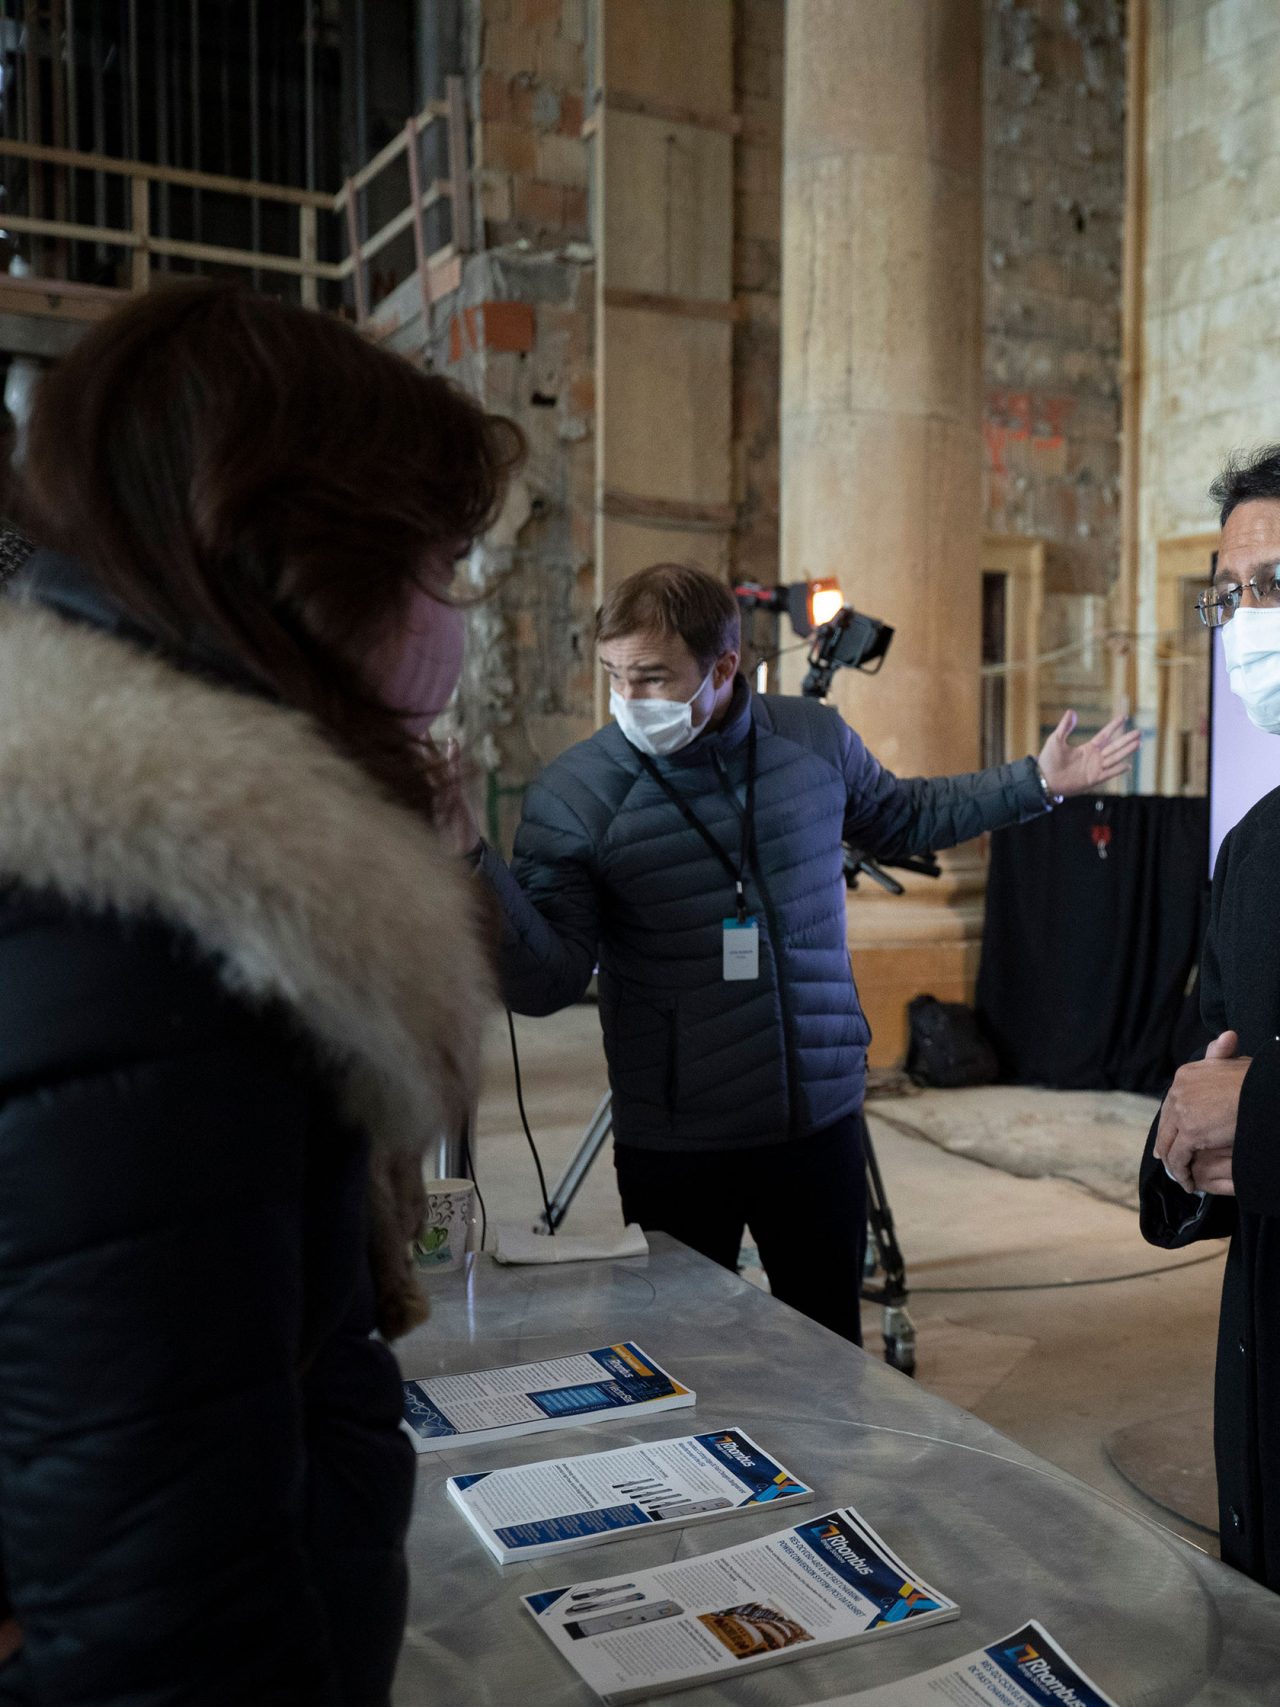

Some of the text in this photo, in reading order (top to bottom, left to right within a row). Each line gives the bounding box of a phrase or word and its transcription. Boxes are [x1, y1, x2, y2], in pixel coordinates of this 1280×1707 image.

[720, 1441, 756, 1467] Rhombus
[827, 1535, 874, 1576] Rhombus
[776, 1539, 796, 1555] POWER
[789, 1552, 818, 1576] CONVERSION
[812, 1574, 833, 1590] SYSTEM
[838, 1595, 866, 1617] DATASHEET
[829, 1575, 843, 1585] FAST
[1026, 1658, 1086, 1707] Rhombus
